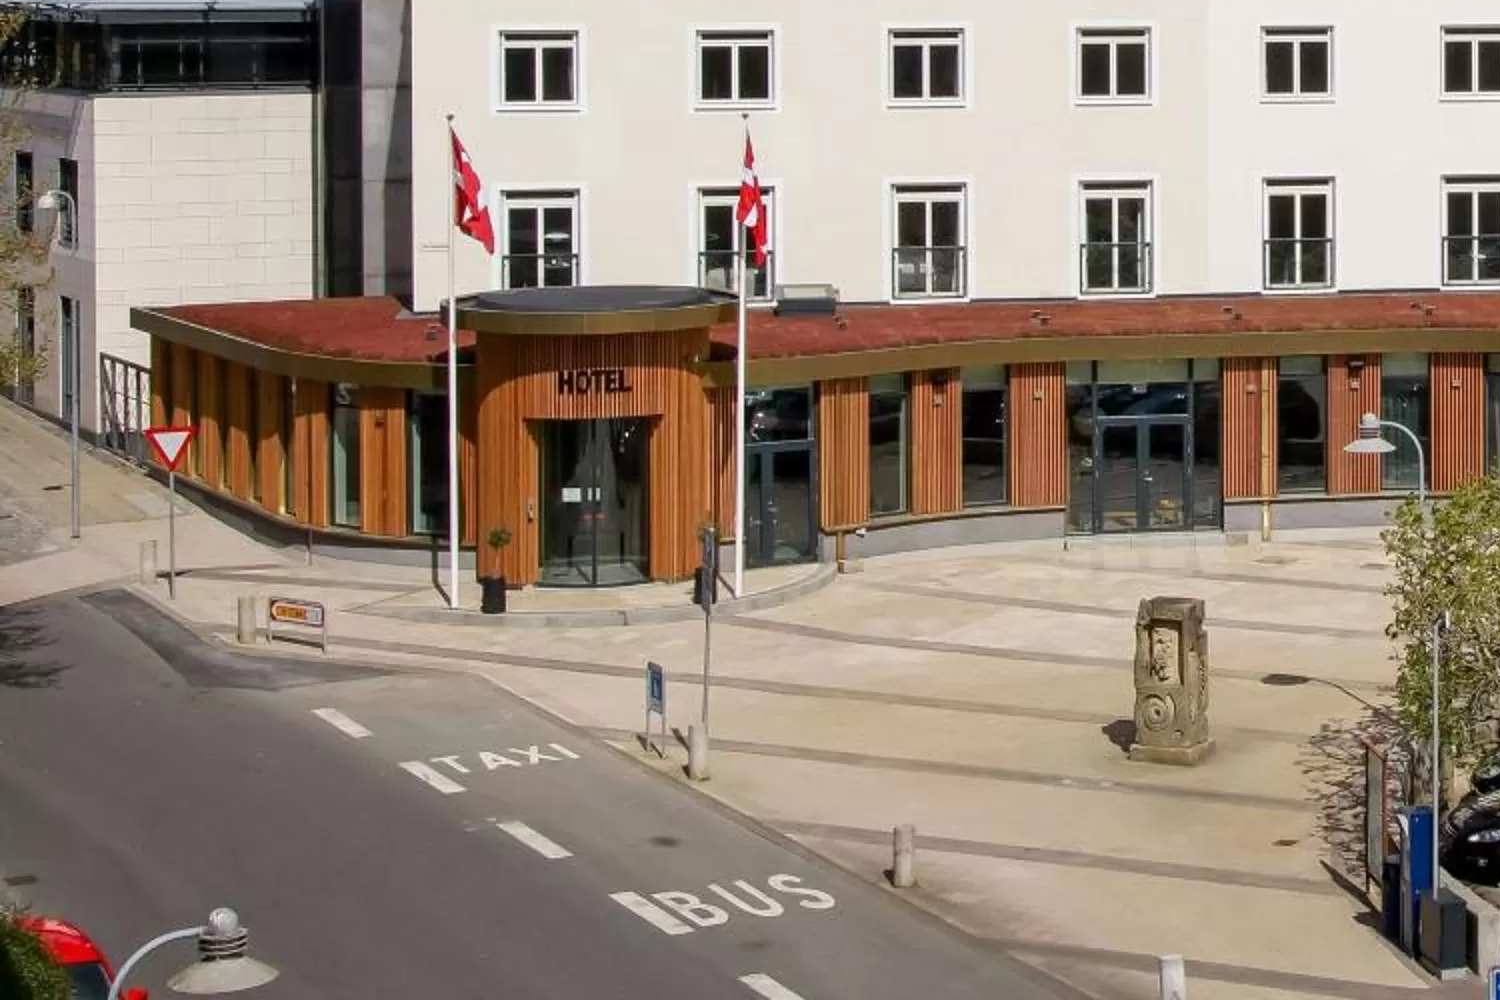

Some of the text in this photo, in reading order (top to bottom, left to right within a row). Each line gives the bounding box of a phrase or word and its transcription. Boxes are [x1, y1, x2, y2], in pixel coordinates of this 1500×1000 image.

[558, 369, 633, 395] HOTEL
[429, 743, 581, 773] TAXI
[652, 873, 836, 927] BUS
